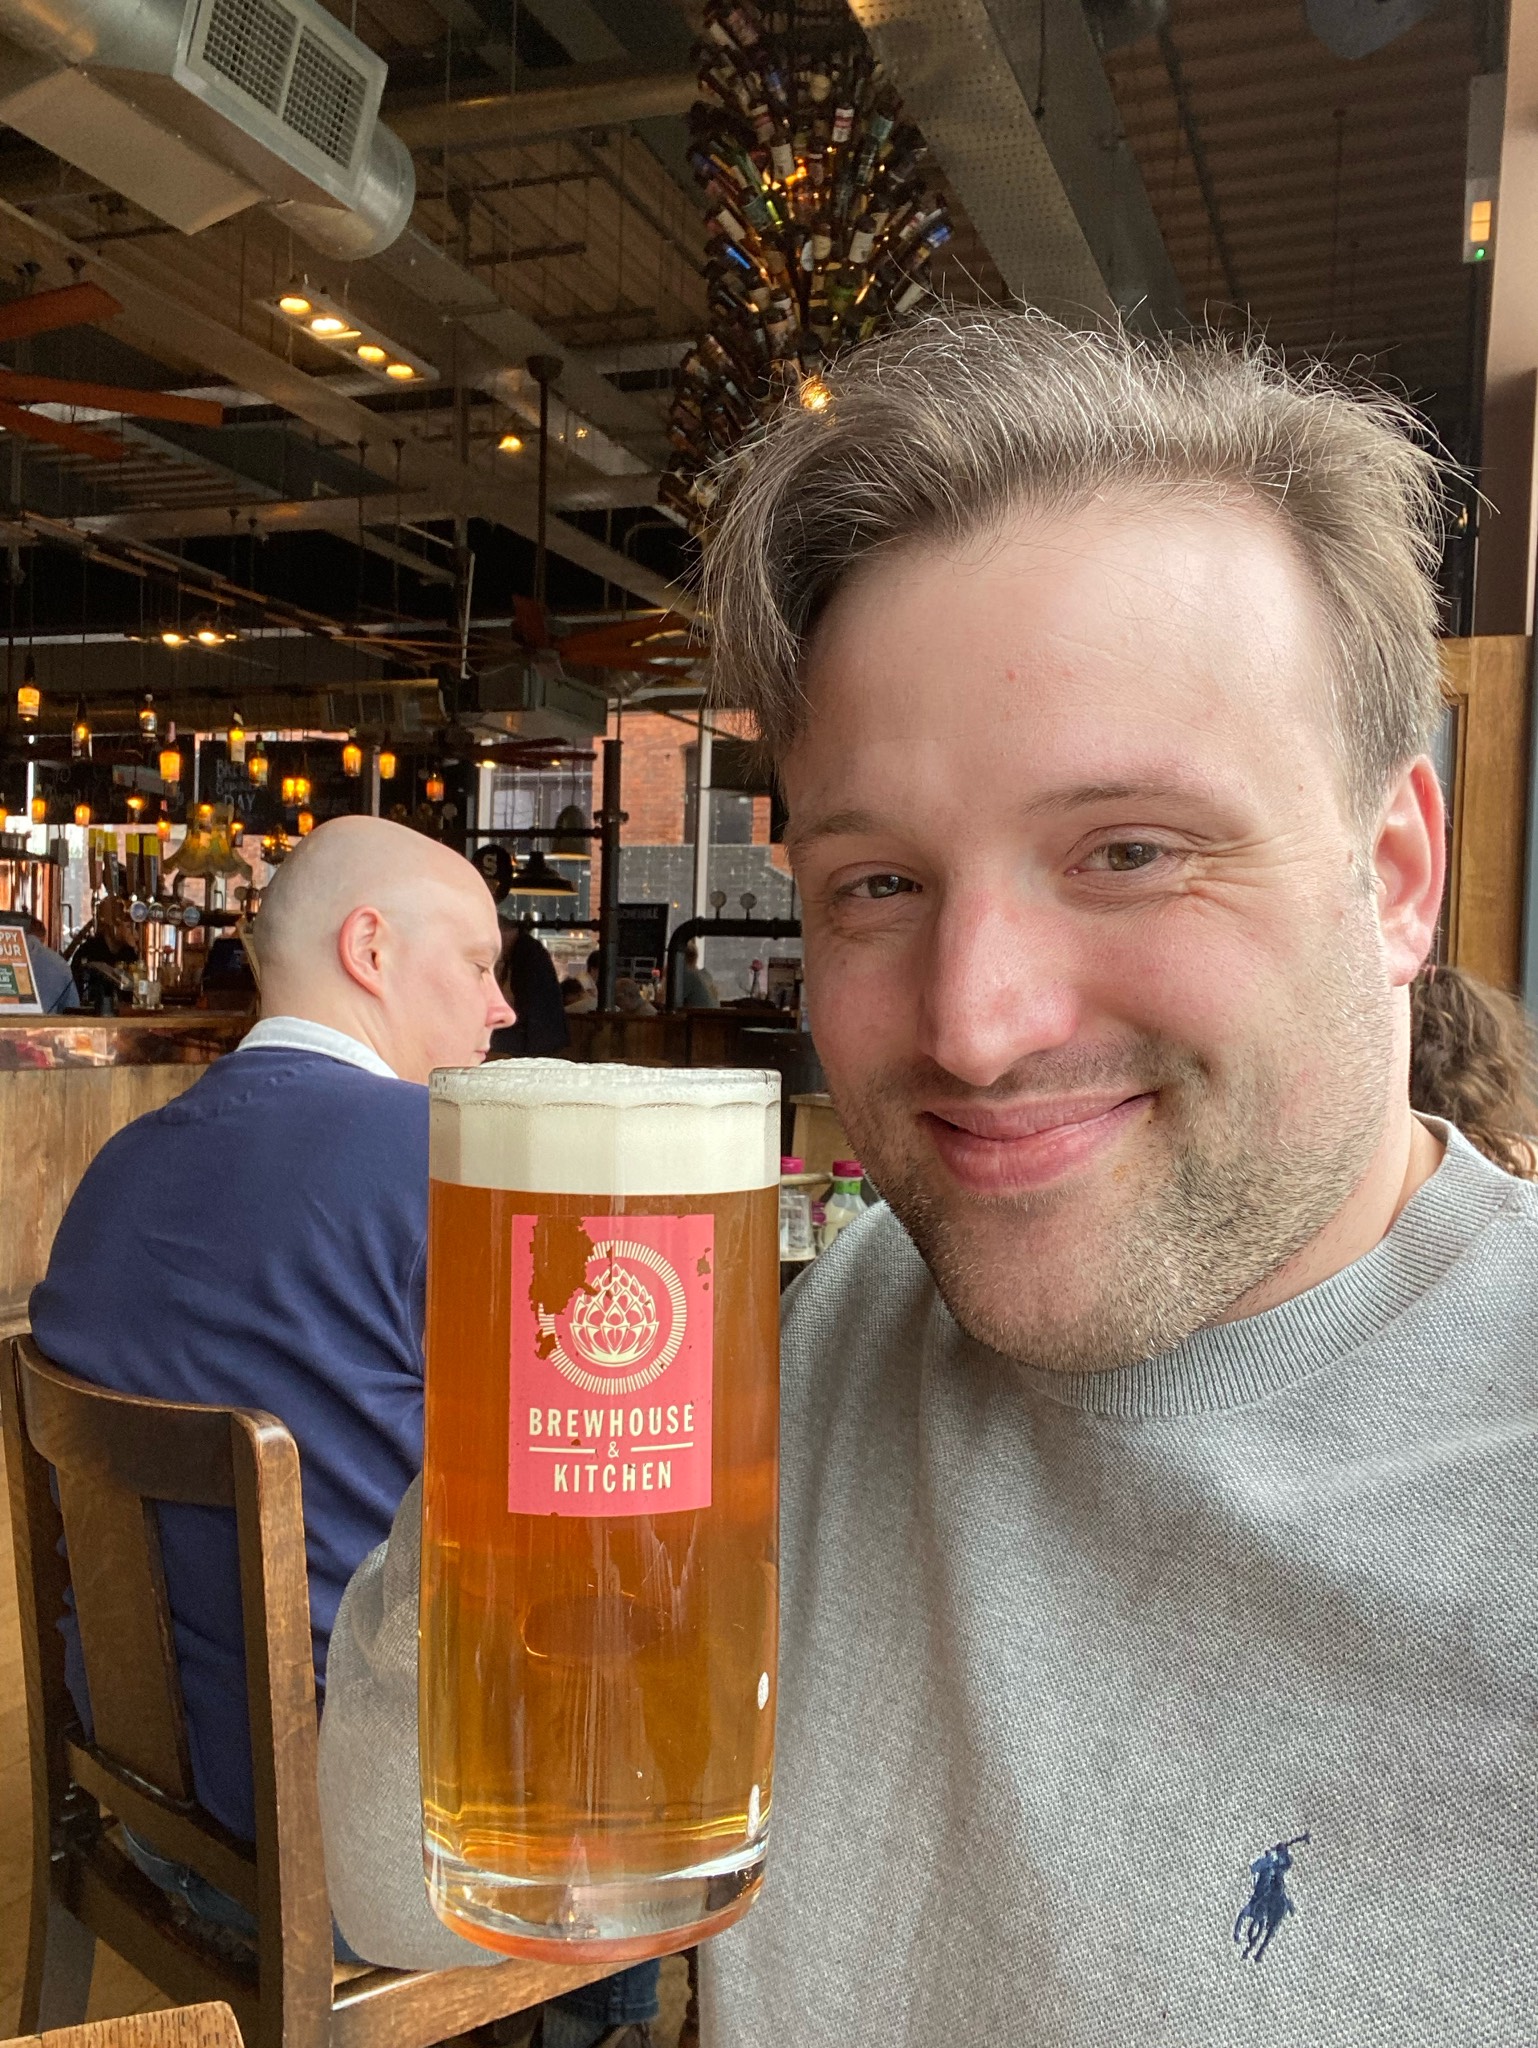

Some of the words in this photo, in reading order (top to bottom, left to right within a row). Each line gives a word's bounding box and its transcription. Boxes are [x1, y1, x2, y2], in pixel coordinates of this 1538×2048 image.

[0, 931, 17, 943] PPY
[529, 1404, 694, 1438] BREWHOUSE
[607, 1441, 620, 1458] &
[554, 1460, 671, 1493] KITCHEN
